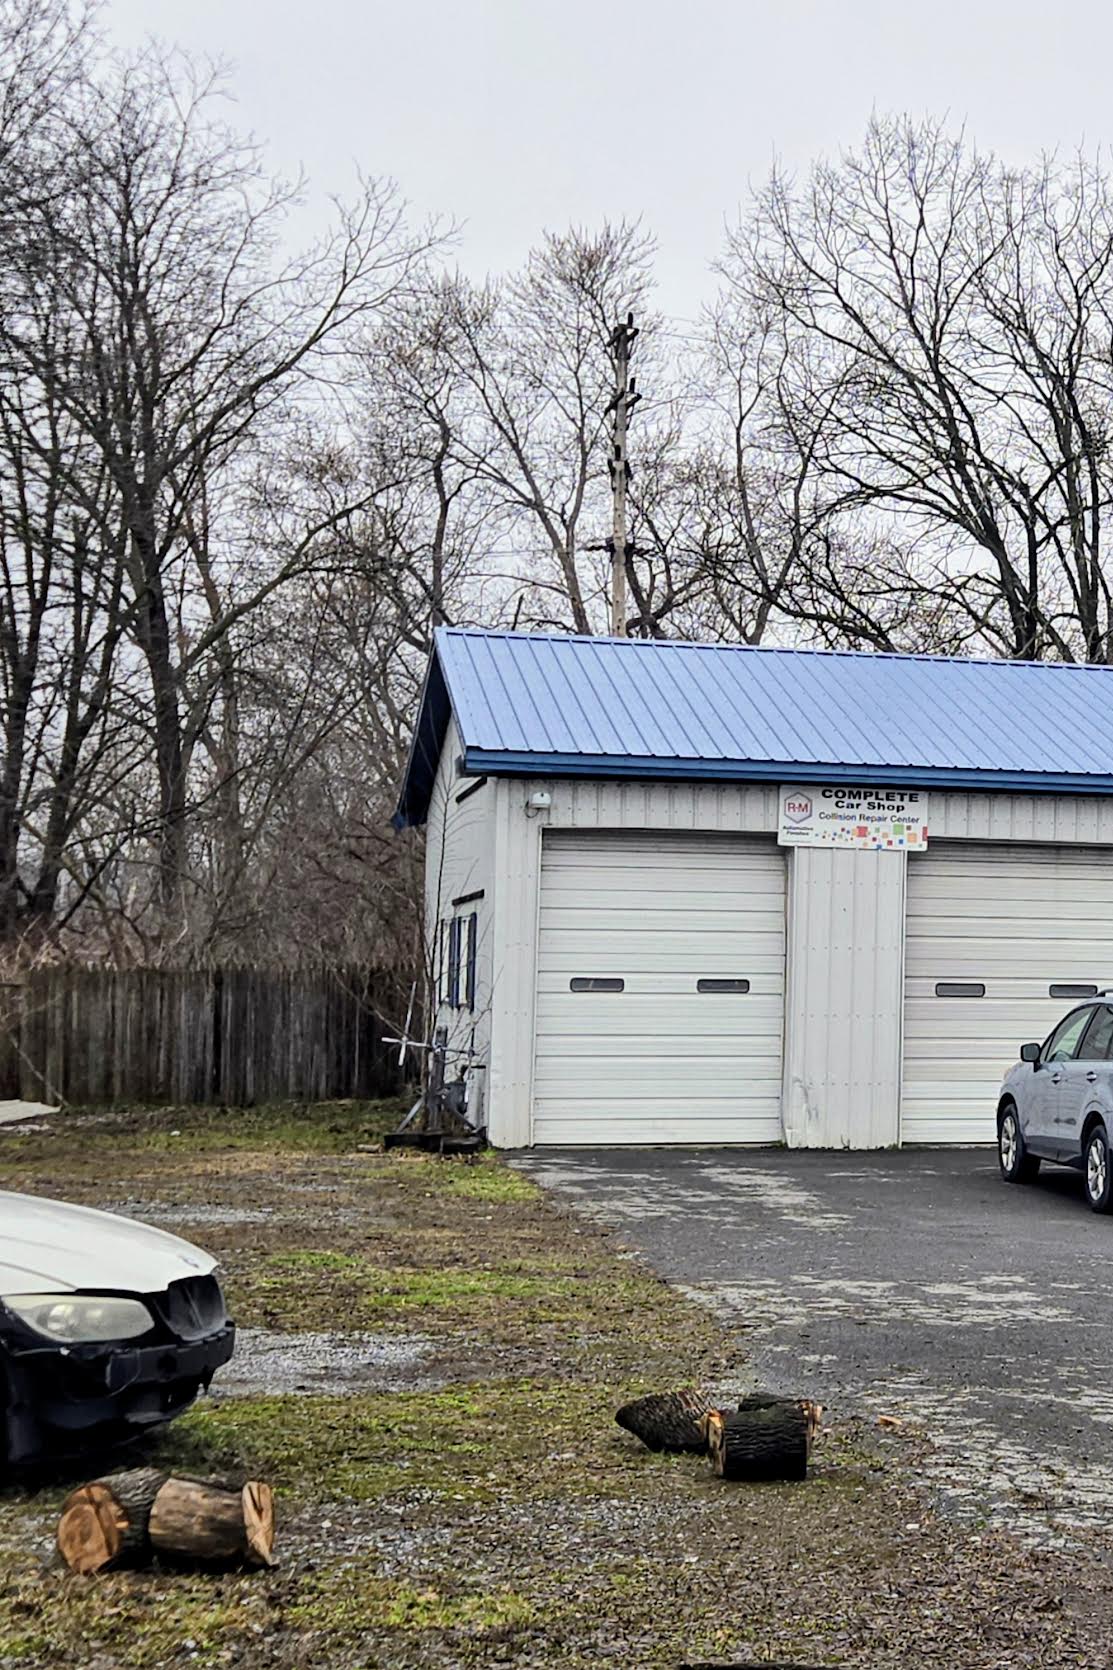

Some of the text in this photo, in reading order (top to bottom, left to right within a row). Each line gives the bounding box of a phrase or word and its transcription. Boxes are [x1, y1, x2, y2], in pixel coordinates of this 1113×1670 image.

[821, 789, 920, 803] COMPLETE
[787, 802, 809, 813] R-M
[834, 800, 905, 813] Car Shop
[818, 811, 920, 824] Collision Repair Center
